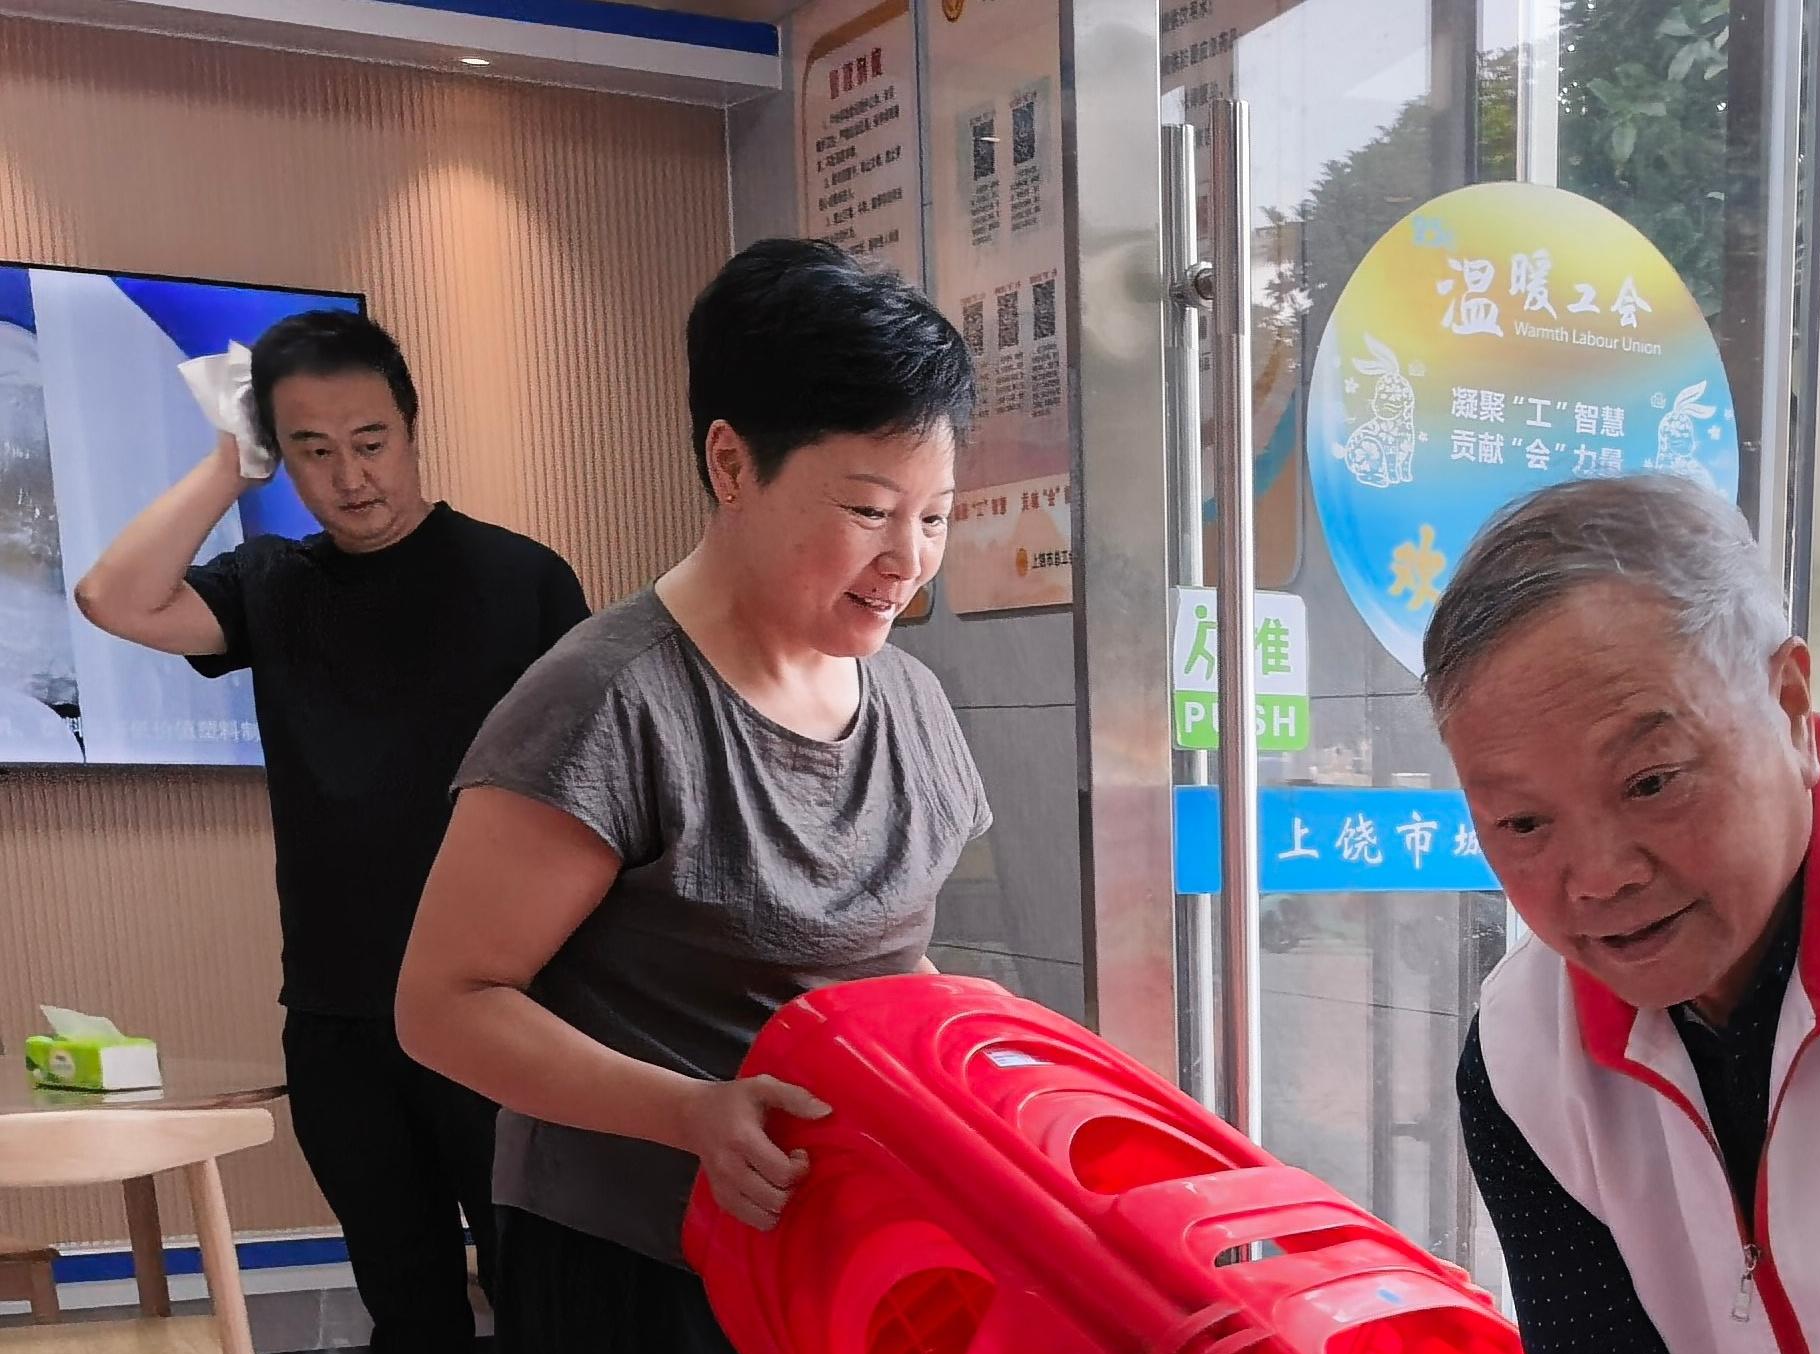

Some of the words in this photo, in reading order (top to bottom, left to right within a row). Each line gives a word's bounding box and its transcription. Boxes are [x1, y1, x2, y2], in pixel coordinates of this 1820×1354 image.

[1436, 249, 1653, 338] 温暖工会
[1514, 320, 1569, 343] Warmth
[1572, 329, 1618, 350] Labour
[1622, 337, 1662, 356] Union
